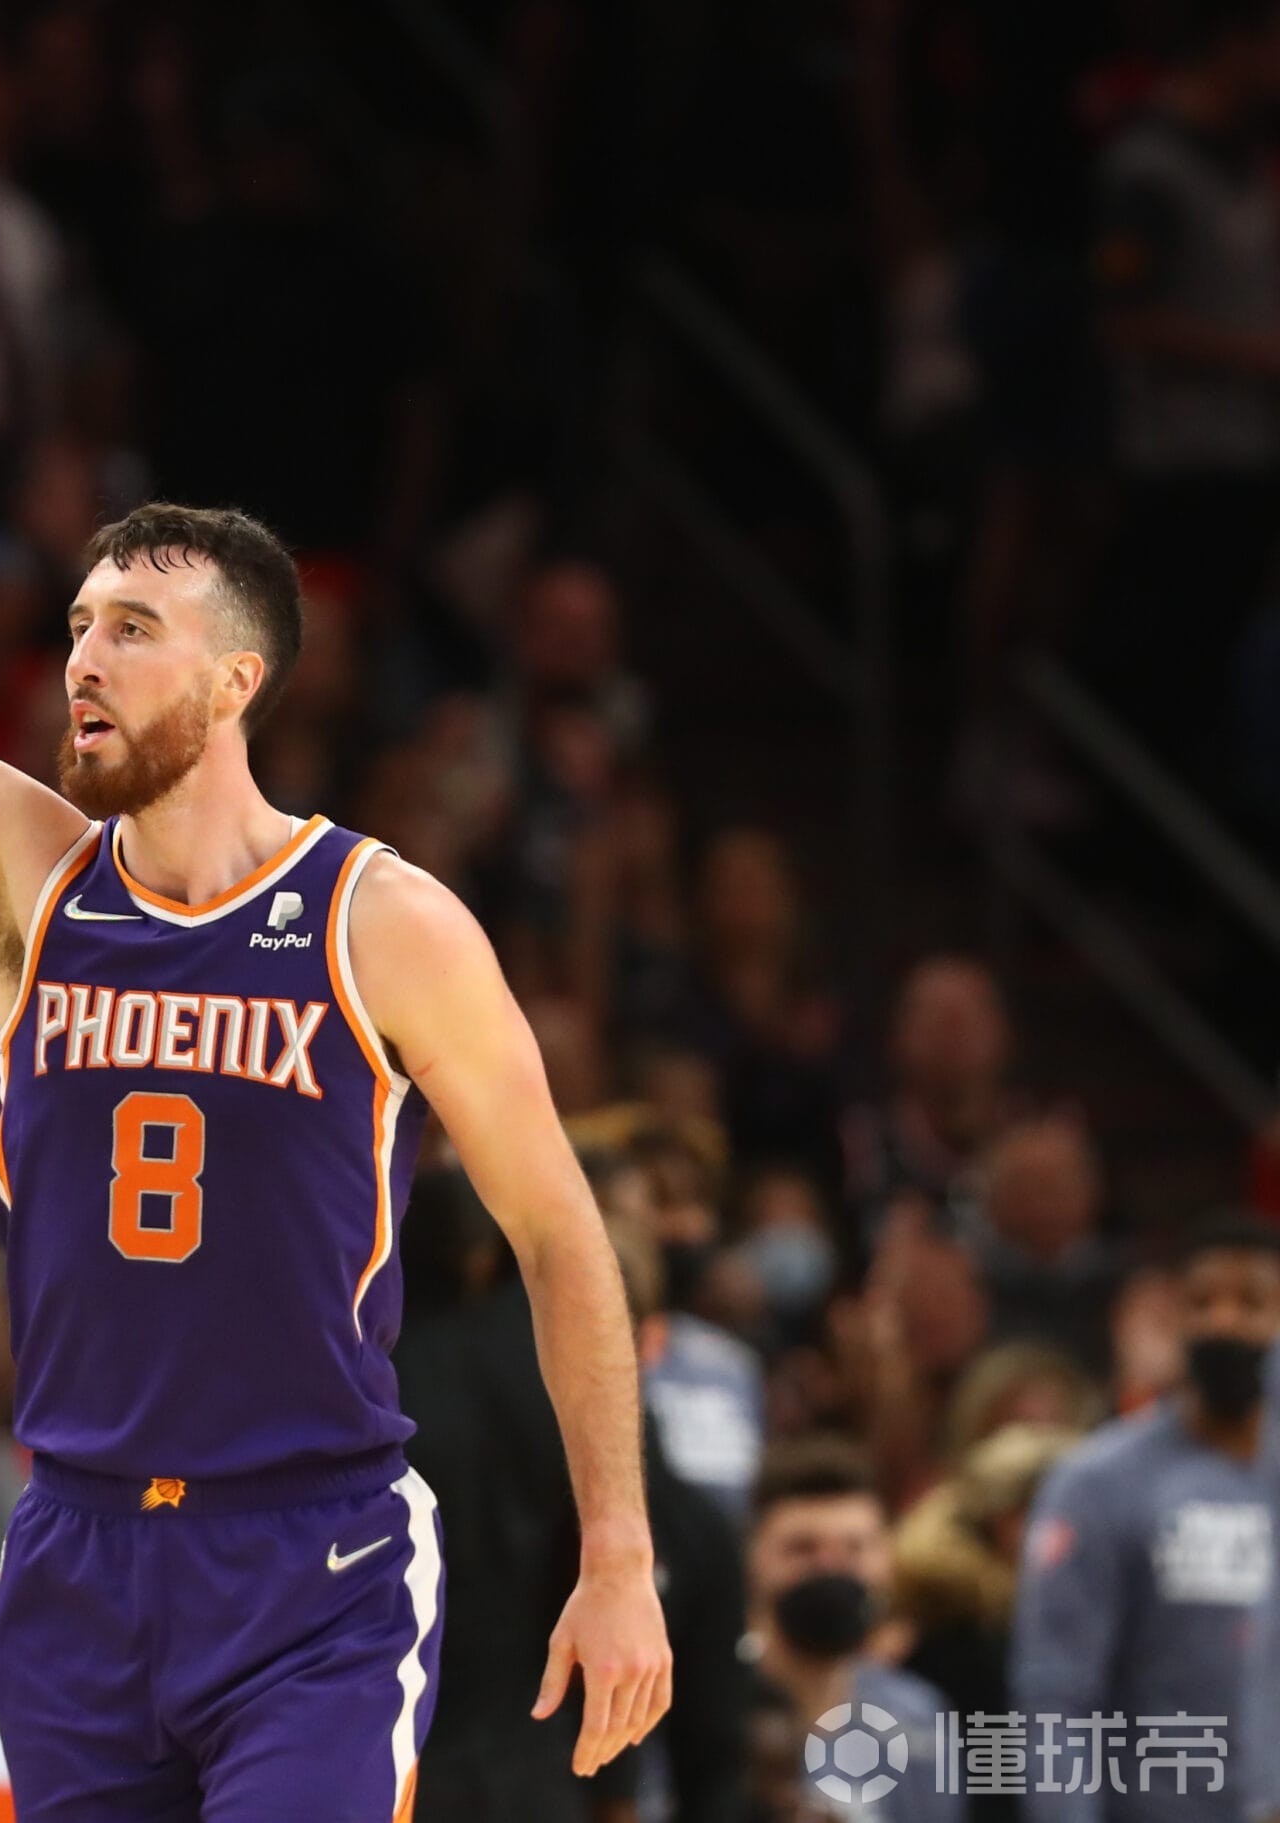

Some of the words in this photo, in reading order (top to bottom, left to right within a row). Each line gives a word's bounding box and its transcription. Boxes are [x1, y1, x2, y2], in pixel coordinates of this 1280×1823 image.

[249, 932, 313, 951] PayPal
[34, 981, 329, 1100] PHOENIX
[109, 1091, 205, 1263] 8
